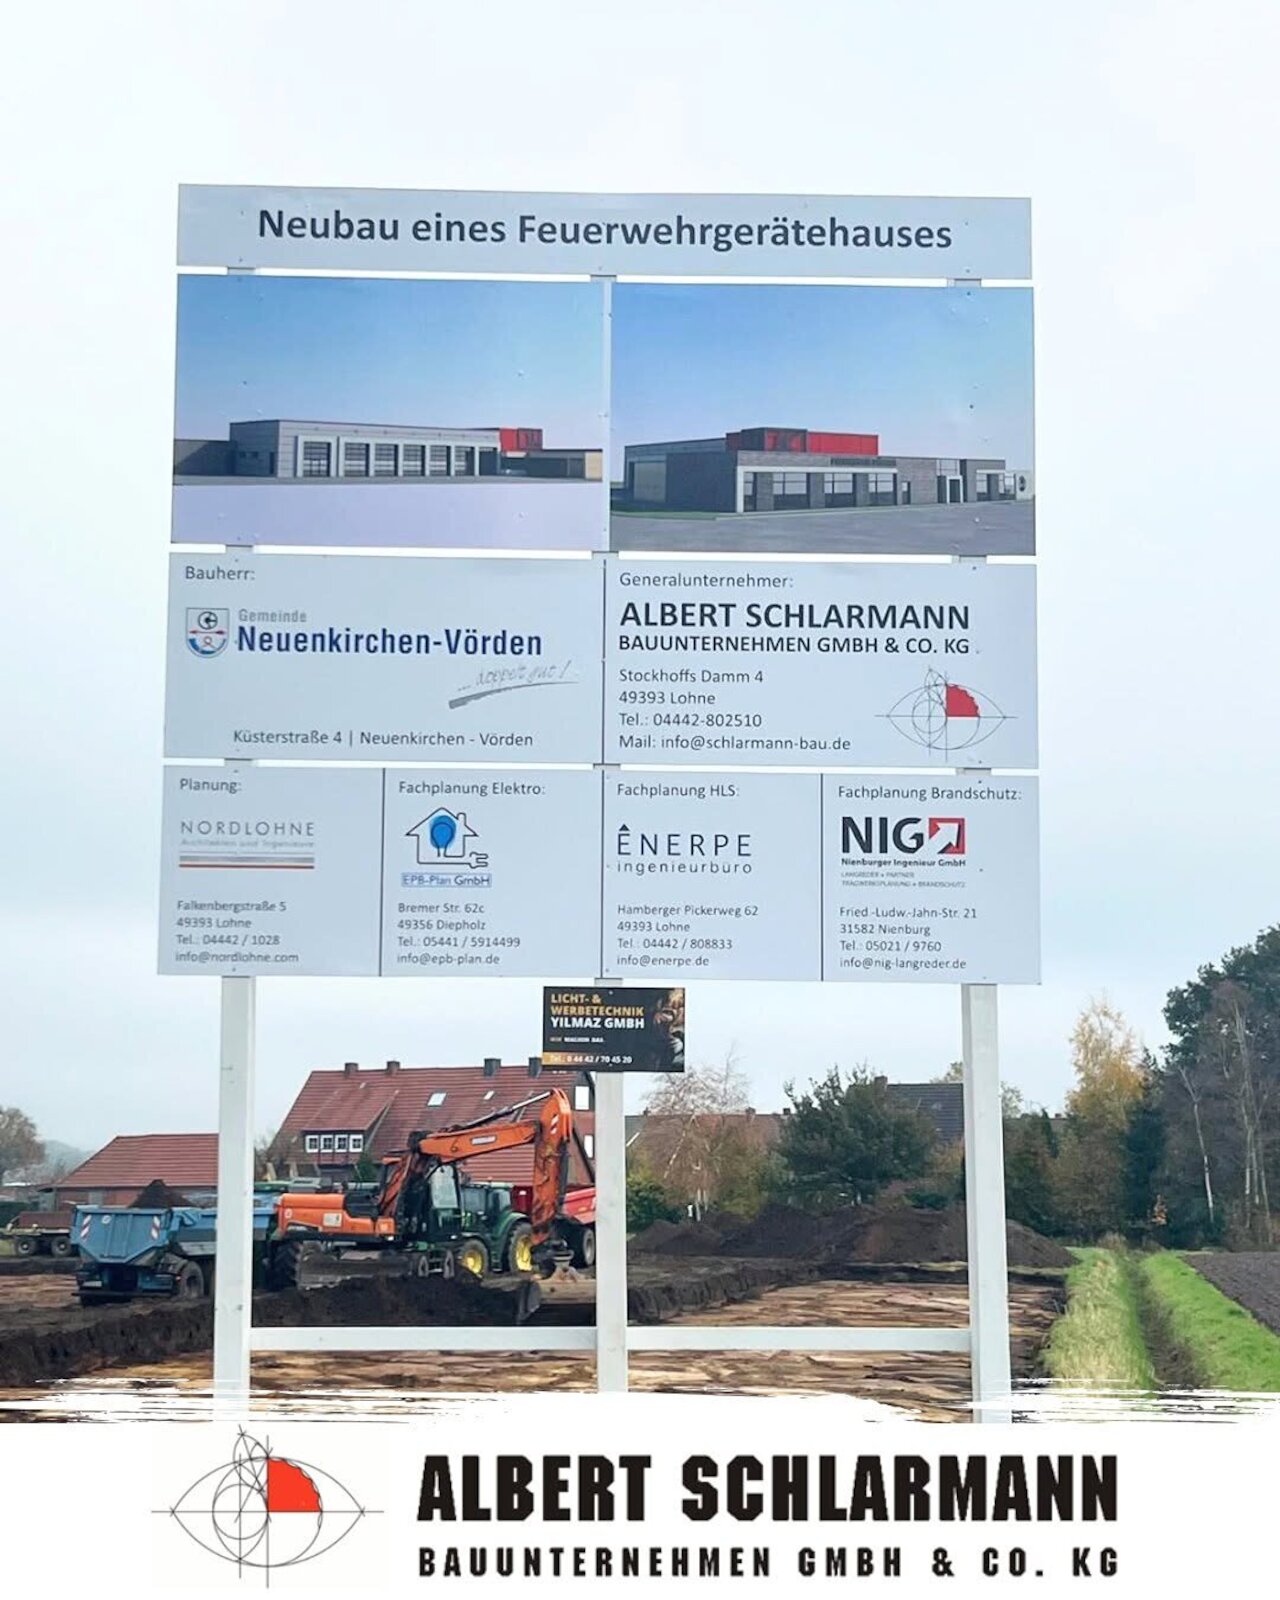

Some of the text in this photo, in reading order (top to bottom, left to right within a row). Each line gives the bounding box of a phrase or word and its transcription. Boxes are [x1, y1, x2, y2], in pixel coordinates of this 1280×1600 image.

[260, 210, 951, 252] Neubau eines Feuerwehrgerätehauses
[186, 566, 255, 580] Bauherr:
[620, 573, 793, 587] Generalunternehmer:
[238, 609, 306, 622] Gemeinde
[620, 602, 968, 629] ALBERT SCHLARMANN
[238, 626, 541, 655] Neuenkirchen-Vörden
[620, 635, 968, 653] BAUUNTERNEHMEN GMBH & CO. KG
[620, 669, 763, 682] Stockhoffs Damm 4
[619, 691, 715, 704] 49393 Lohne
[619, 713, 761, 727] Tel.: 04442-802510
[234, 730, 328, 744] Küsterstraße
[333, 731, 341, 743] 4
[360, 732, 464, 745] Neuenkirchen
[480, 733, 532, 746] Vörden
[620, 735, 850, 750] Mail: info@schlarmann-bau.de
[180, 778, 241, 794] Planung:
[399, 781, 545, 797] Fachplanung Elektro:
[618, 784, 739, 799] Fachplanung HLS:
[839, 786, 1022, 801] Fachplanung Brandschutz:
[181, 821, 313, 836] NORDLOHNE
[842, 817, 924, 854] NIG
[842, 858, 891, 867] Nienburger
[894, 859, 936, 868] Ingenieur
[402, 873, 490, 887] EPB-Plan GmbH
[177, 900, 286, 913] Falkenbergstraße 5
[398, 903, 484, 913] Bremer Str. 62c
[618, 905, 758, 918] Hamberger Pickerweg 62
[964, 908, 976, 918] 21
[176, 917, 252, 928] 49393 Lohne
[397, 920, 485, 931] 49356 Diepholz
[617, 921, 690, 932] 49393 Lohne
[841, 924, 930, 937] 31582 Nienburg
[203, 935, 238, 945] 04442
[241, 934, 249, 946] /
[252, 935, 280, 945] 1028
[397, 936, 520, 948] Tel.: 05441 / 5914499
[643, 939, 678, 949] 04442
[681, 938, 687, 950] /
[690, 939, 732, 949] 808833
[866, 941, 900, 951] 05021
[904, 940, 910, 952] /
[913, 941, 941, 952] 9760
[175, 951, 299, 963] info@nordlohne.com
[397, 953, 500, 965] info@epb-plan.de
[617, 954, 709, 967] info@enerpe.de
[840, 957, 966, 970] info@nig-langreder.de
[551, 994, 601, 1003] LICHT- &
[551, 1006, 643, 1017] WERBETECHNIK
[551, 1017, 644, 1028] YILMAZ GMBH
